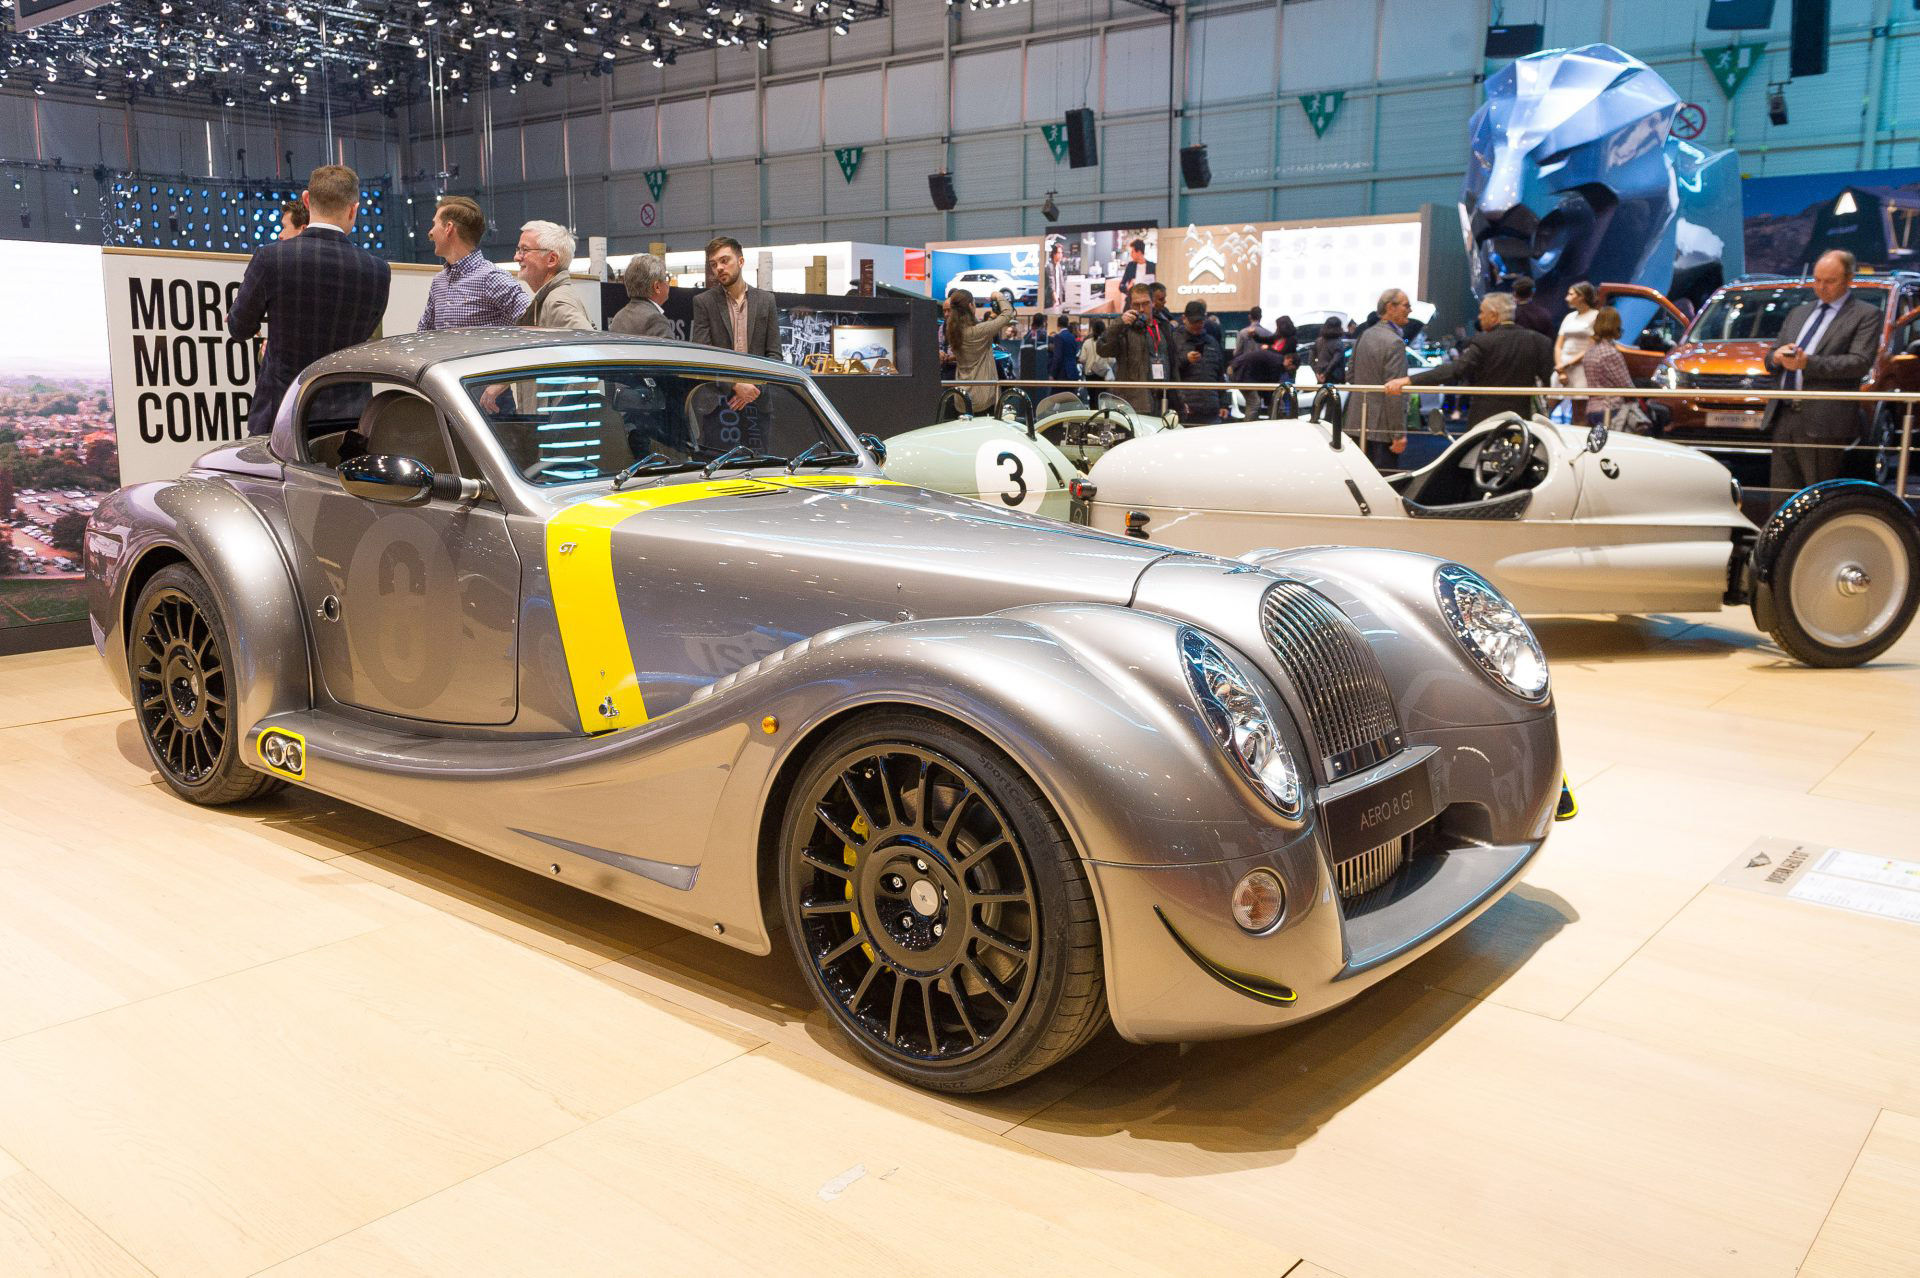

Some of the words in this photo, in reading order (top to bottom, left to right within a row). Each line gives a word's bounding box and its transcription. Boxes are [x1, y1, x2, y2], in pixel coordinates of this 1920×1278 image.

[138, 391, 252, 444] COMP
[996, 451, 1027, 507] 3
[559, 541, 577, 553] GT
[1360, 802, 1391, 831] AERO
[1392, 797, 1400, 815] 8
[1401, 789, 1414, 811] GT
